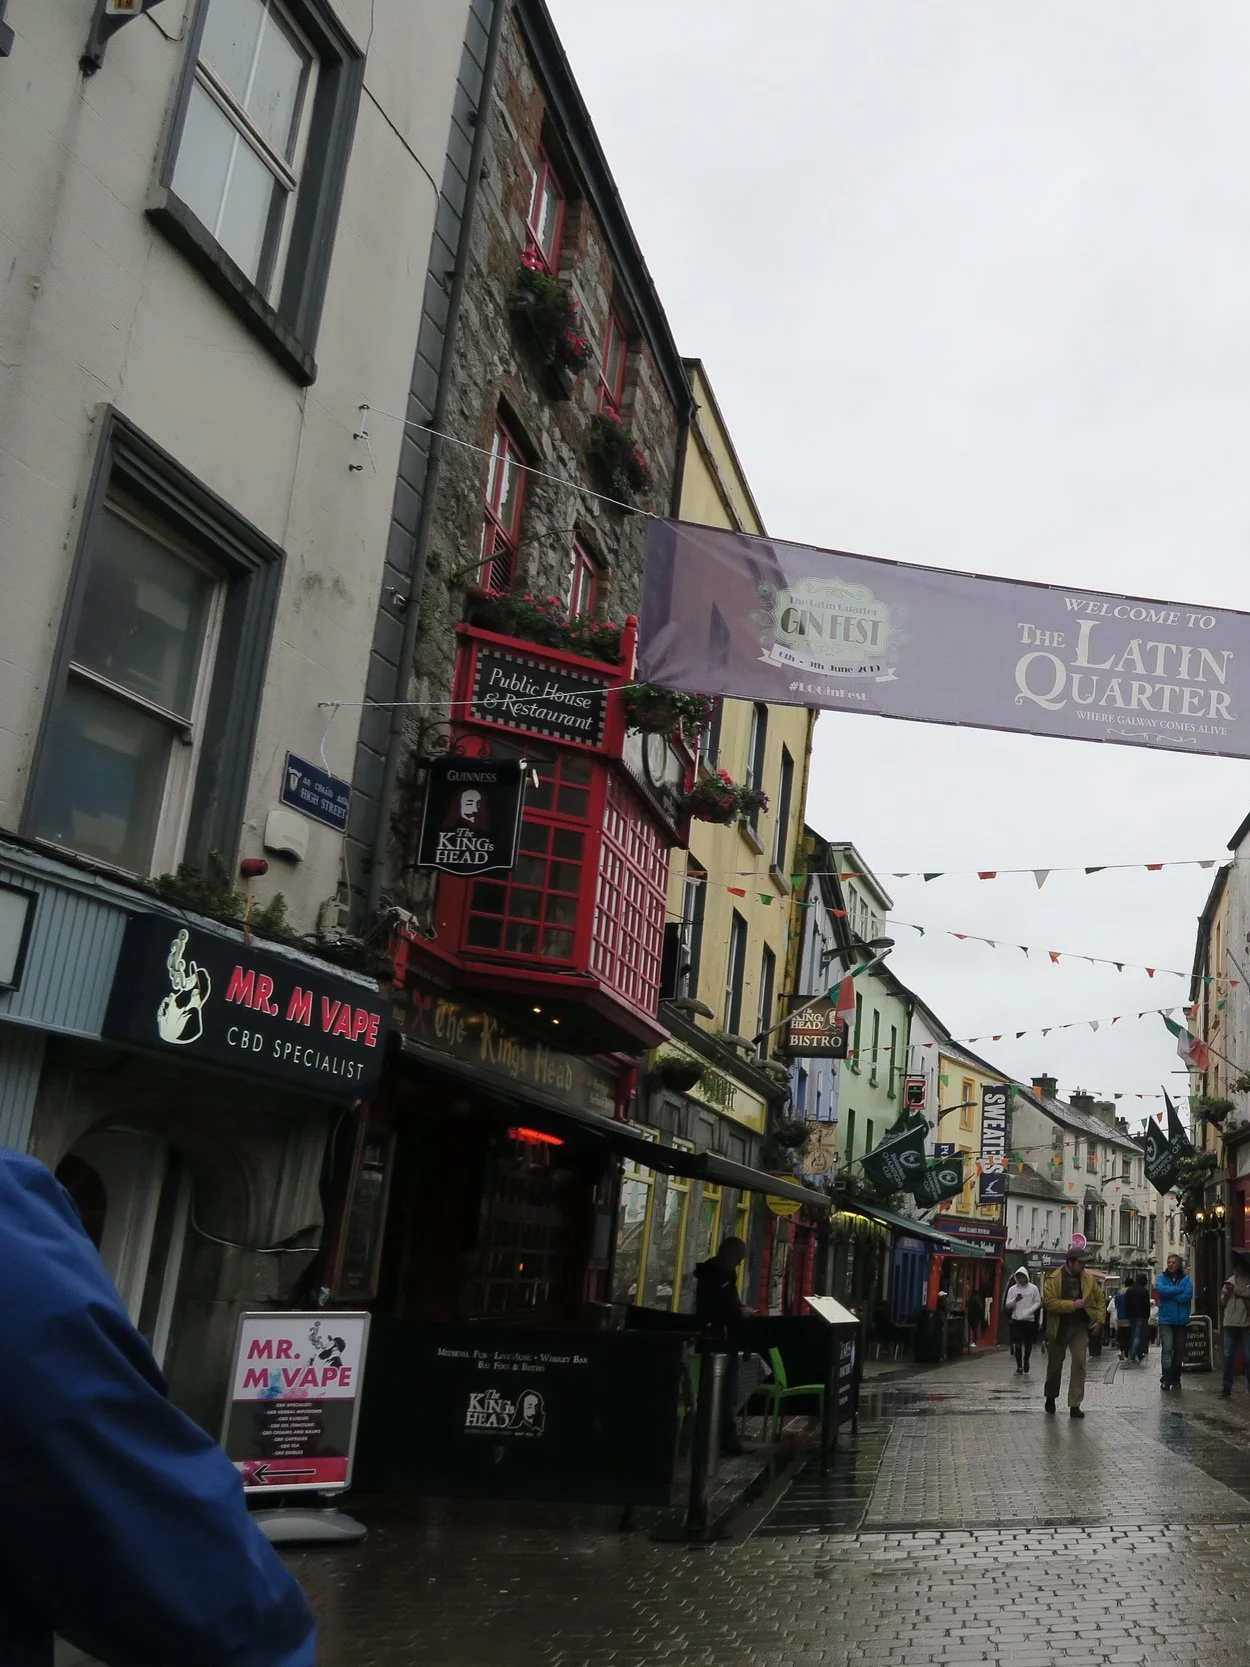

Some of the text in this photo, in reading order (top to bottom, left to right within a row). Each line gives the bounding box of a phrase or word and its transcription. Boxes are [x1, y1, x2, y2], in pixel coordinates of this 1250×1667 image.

[780, 607, 884, 646] GIN FEST
[1063, 597, 1216, 630] WELCOME TO
[1017, 619, 1234, 684] THE LATIN
[488, 668, 592, 709] Public House
[1014, 652, 1238, 720] QUARTER
[484, 692, 593, 730] & Restaurant
[1076, 710, 1228, 736] WHERE GALWAY COMES ALIVE
[446, 770, 497, 783] GUINNESS
[300, 788, 347, 820] HIGH STREET
[457, 828, 474, 838] The
[436, 850, 489, 864] HEAD
[225, 964, 380, 1048] MR. M VAPE
[790, 1020, 821, 1030] HEAD
[227, 1026, 364, 1080] CBD SPECIALIST
[434, 998, 467, 1045] The
[534, 1042, 573, 1091] Head
[789, 1034, 842, 1048] BISTRO
[247, 1339, 301, 1360] MR.
[242, 1367, 352, 1389] M VAPE
[485, 1390, 501, 1400] The
[465, 1412, 510, 1428] HEAD
